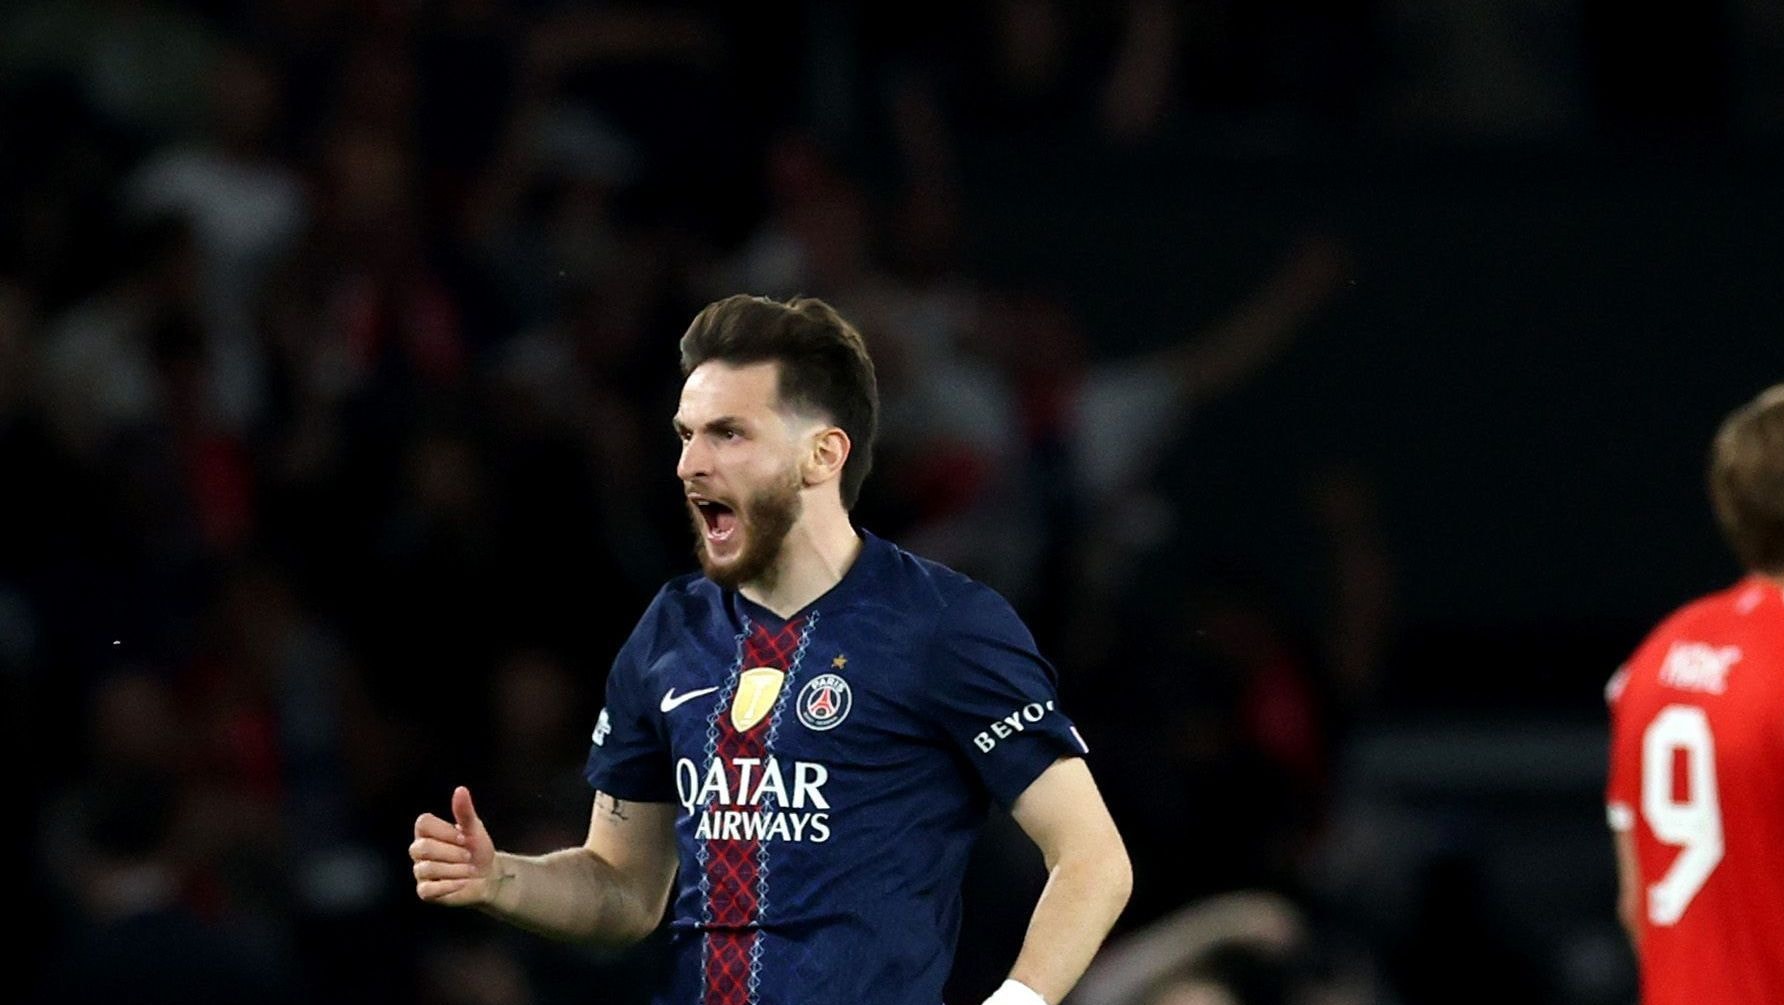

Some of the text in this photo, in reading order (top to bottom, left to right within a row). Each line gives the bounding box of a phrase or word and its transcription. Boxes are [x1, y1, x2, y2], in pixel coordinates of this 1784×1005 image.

[973, 700, 1054, 753] BEYO
[676, 754, 831, 817] QATAR
[695, 809, 831, 843] AIRWAYS
[1641, 703, 1726, 927] 9
